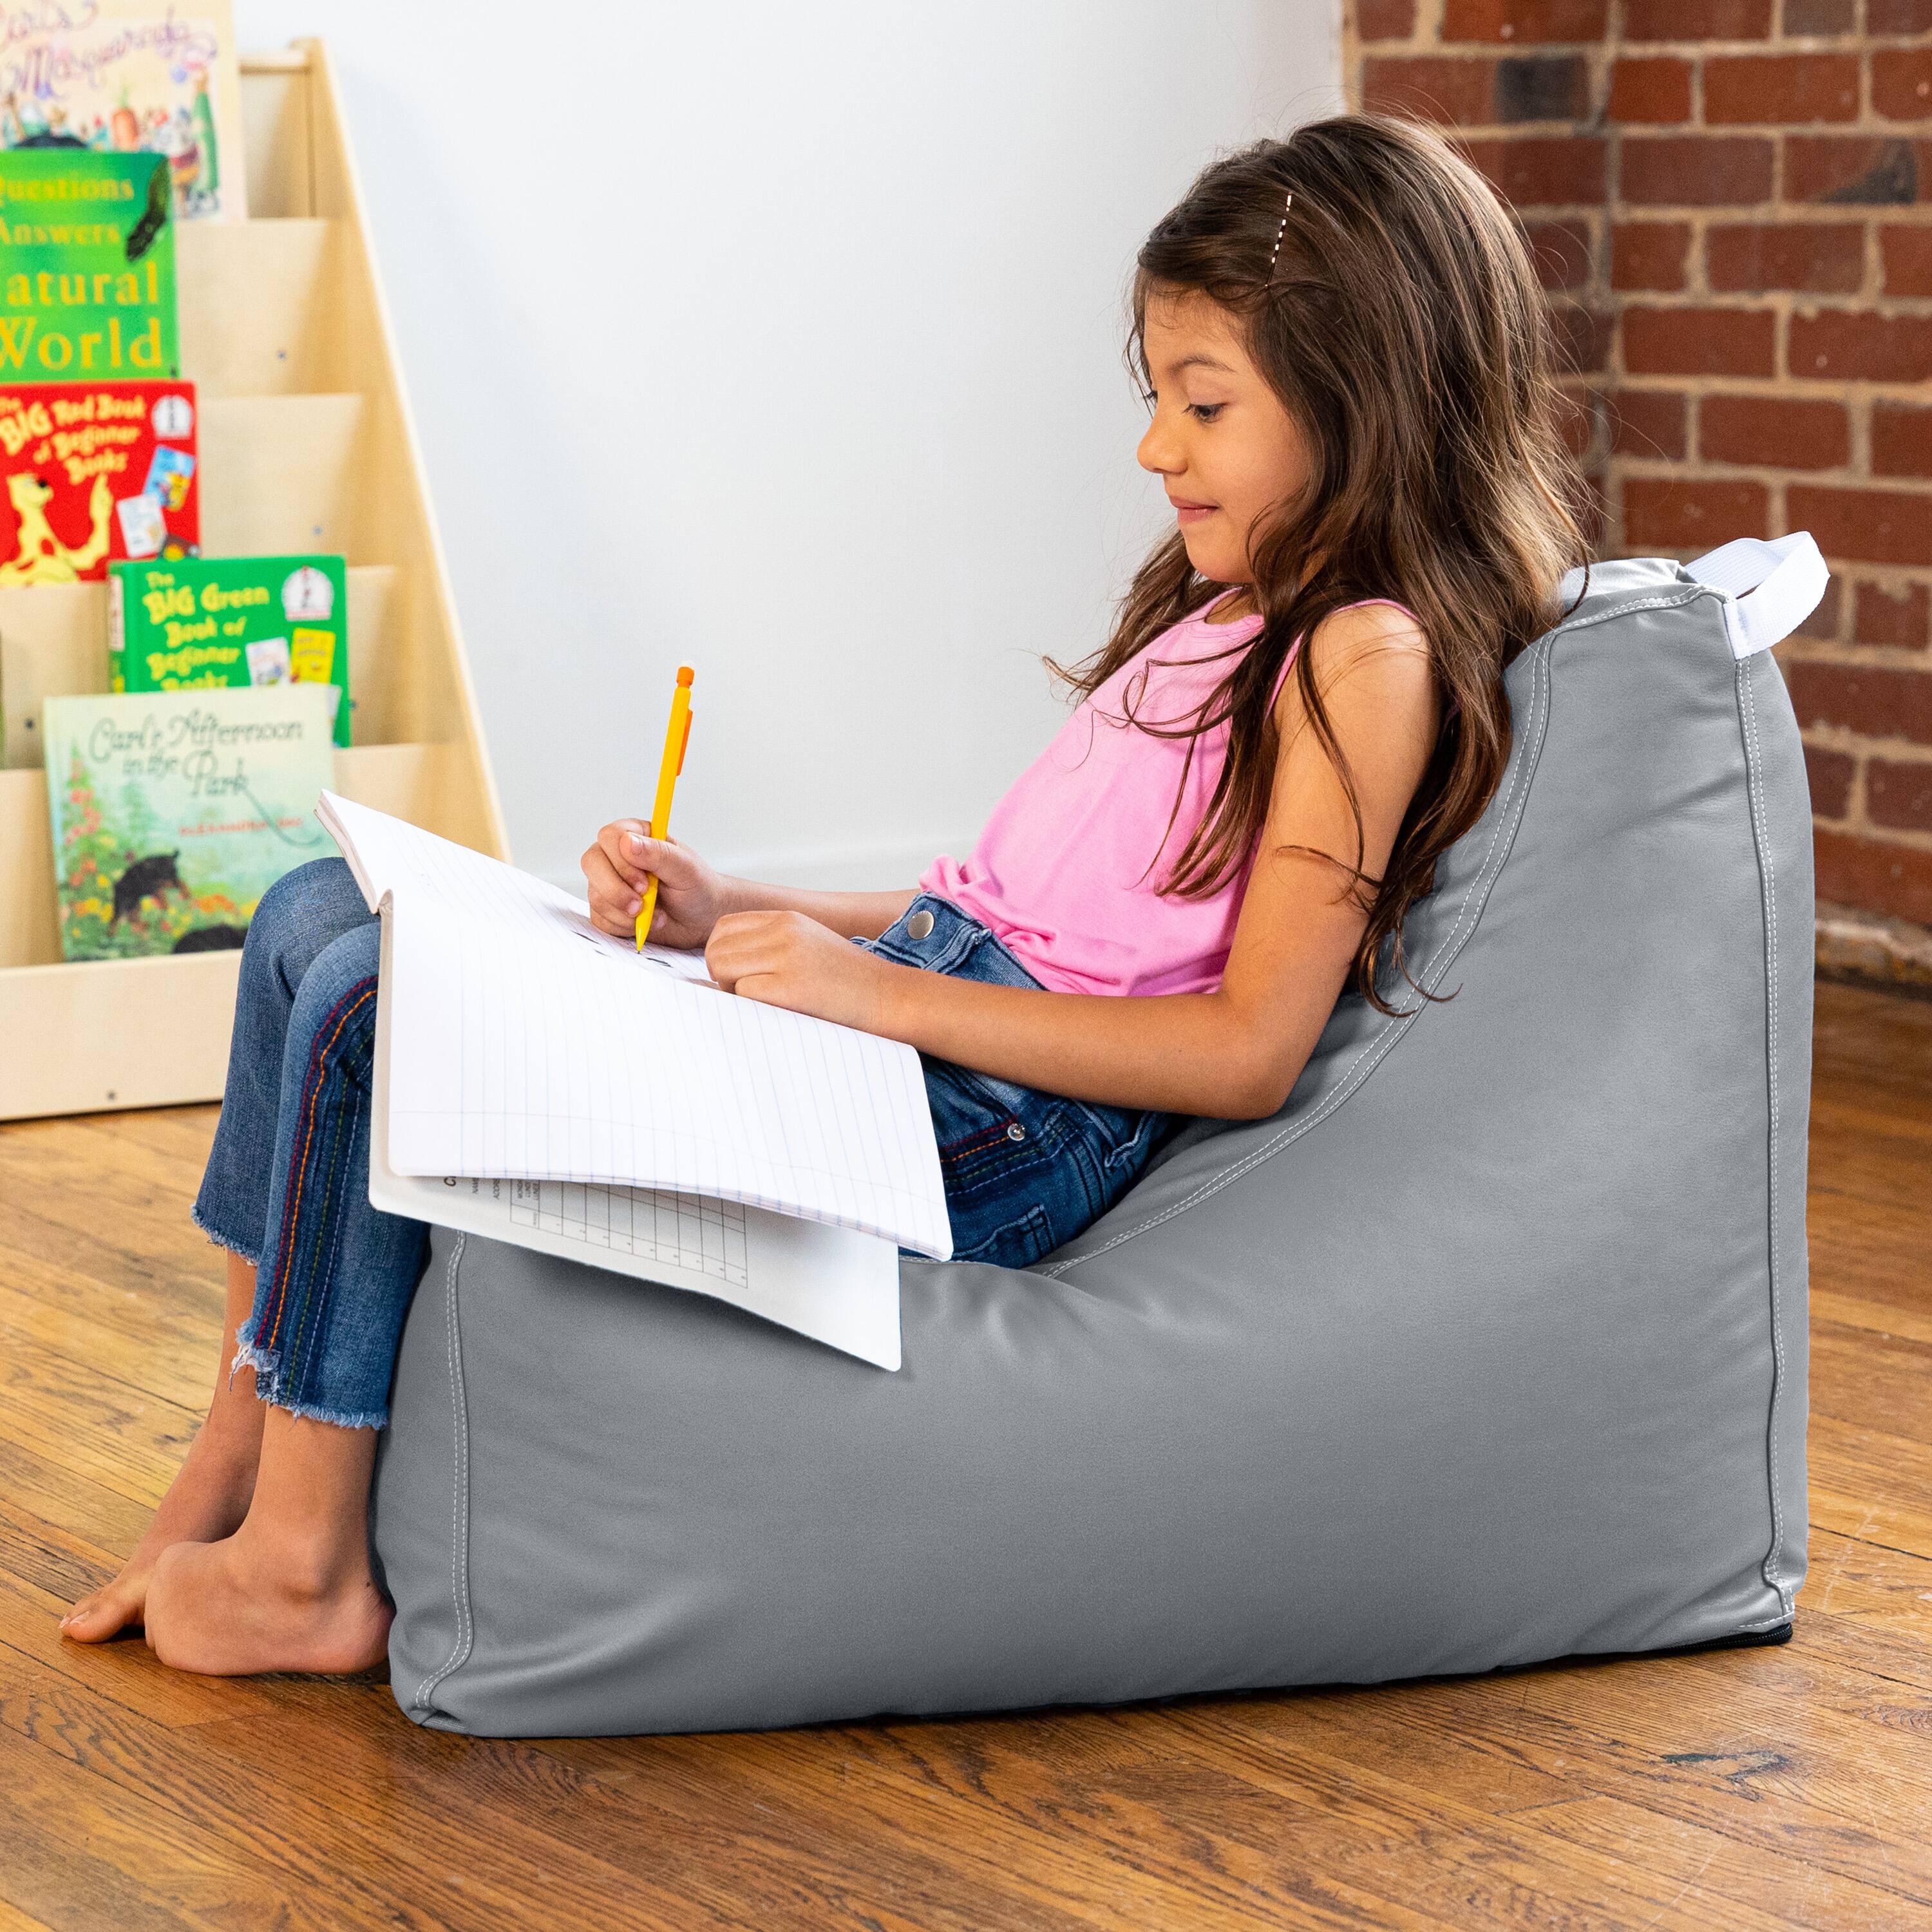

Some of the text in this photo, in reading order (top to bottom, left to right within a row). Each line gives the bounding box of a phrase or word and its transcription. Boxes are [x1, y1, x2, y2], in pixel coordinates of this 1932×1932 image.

[0, 175, 134, 208] uestions
[6, 260, 158, 306] atural
[0, 393, 145, 456] BIG Red Book
[33, 425, 141, 464] of Beginner
[64, 448, 128, 486] Books
[146, 571, 175, 589] The
[142, 582, 270, 625] BIG Green
[164, 615, 247, 649] Book of
[147, 646, 240, 681] Beginner
